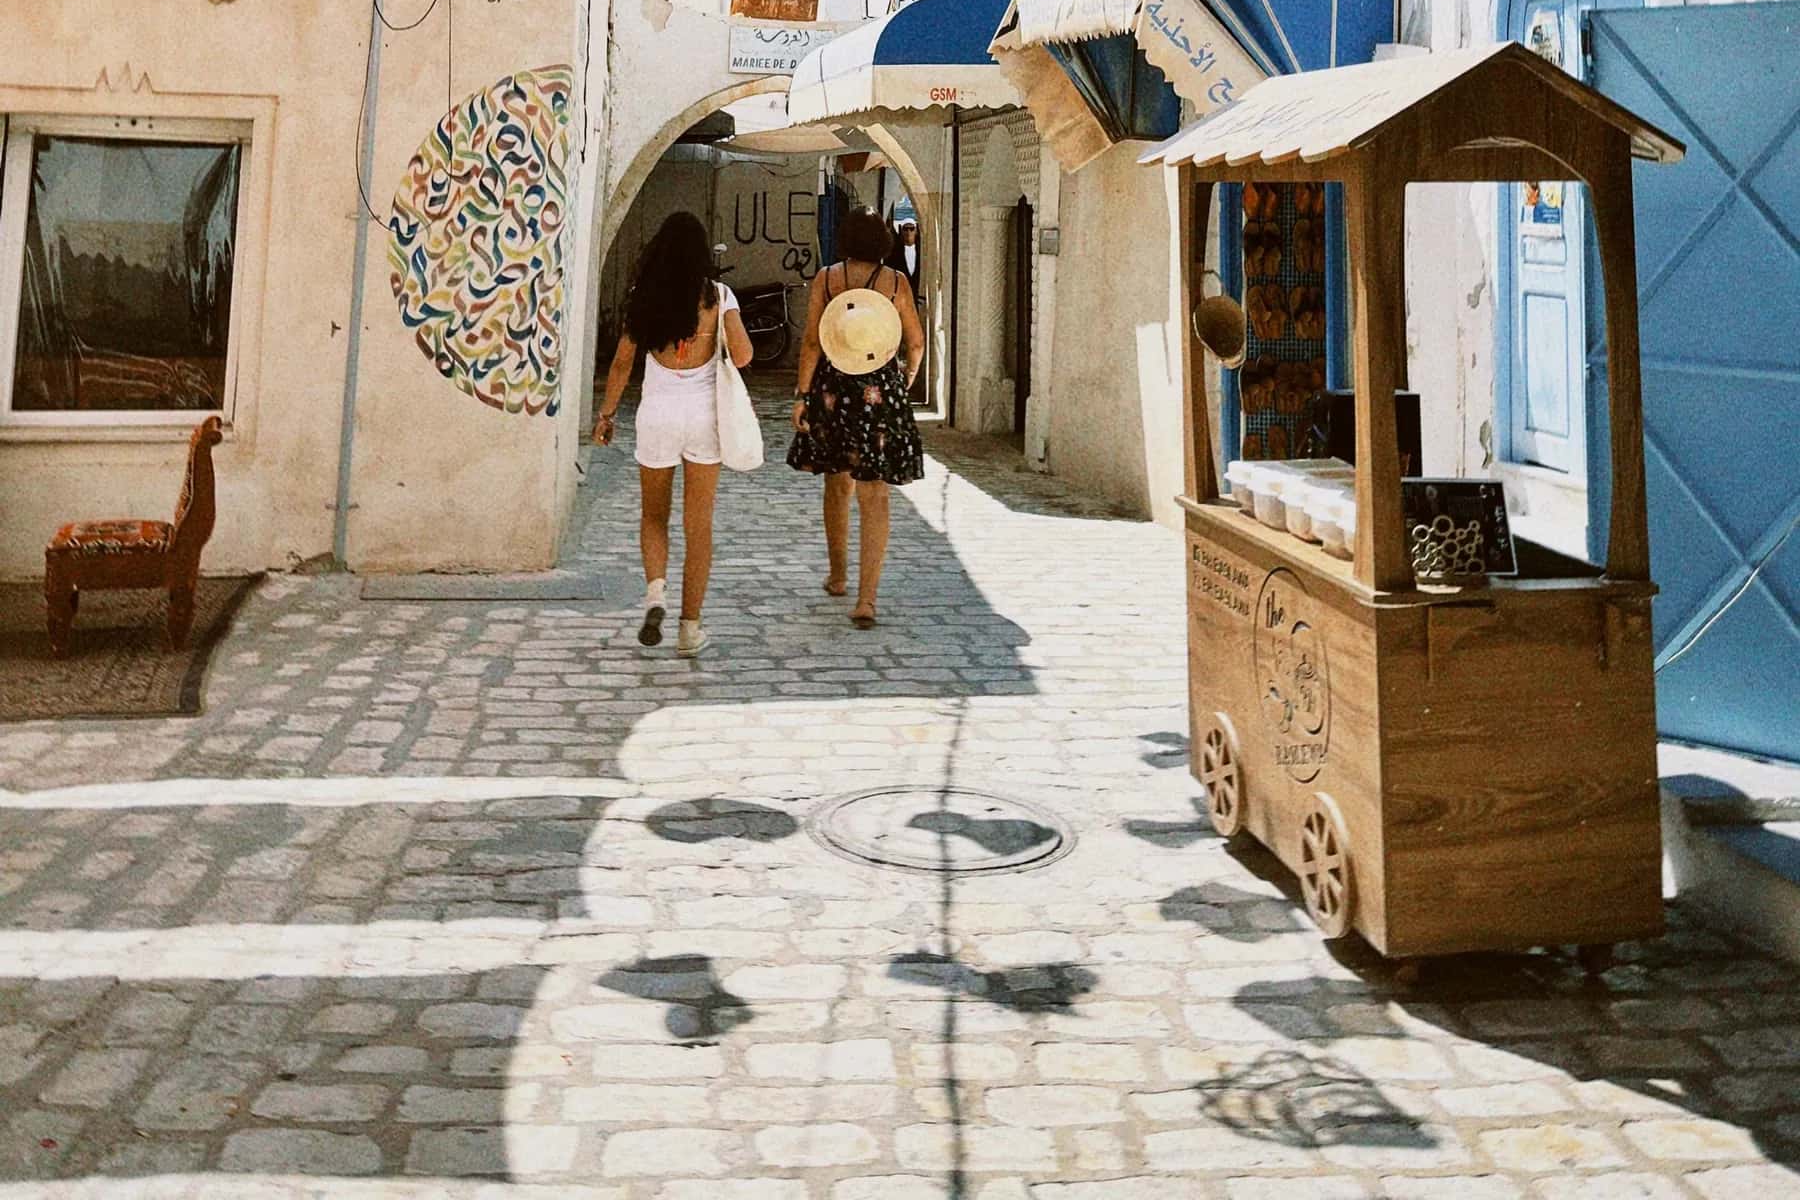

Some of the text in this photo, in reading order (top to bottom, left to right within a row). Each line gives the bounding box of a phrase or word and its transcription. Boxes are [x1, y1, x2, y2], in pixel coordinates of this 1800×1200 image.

[732, 57, 771, 69] MARIEE
[773, 58, 785, 69] DE
[930, 87, 957, 101] GSM
